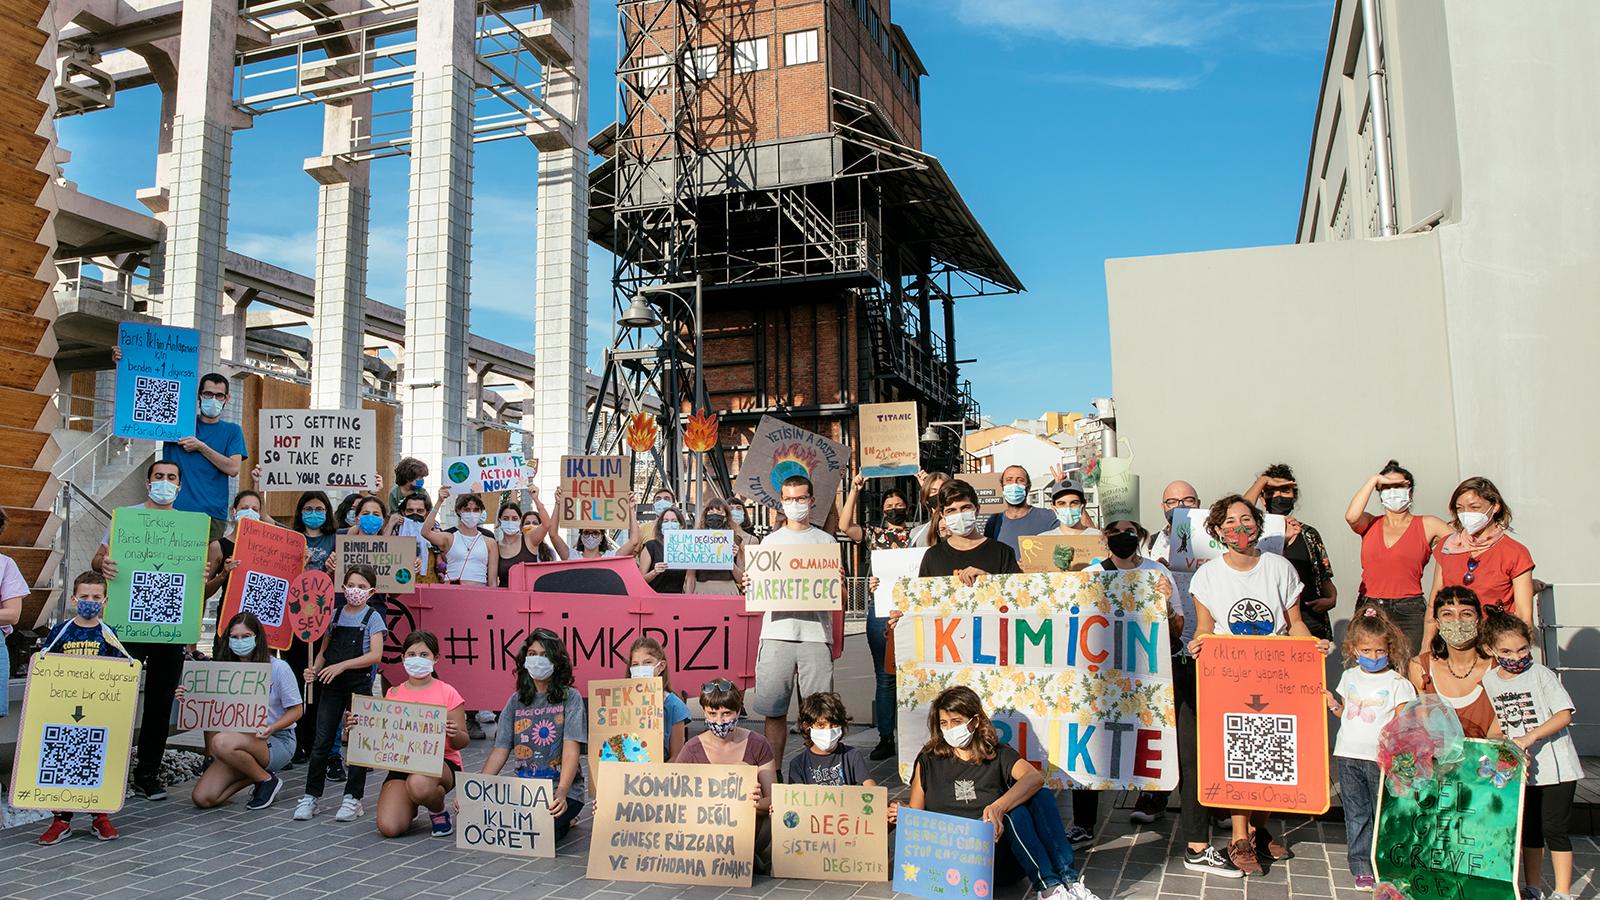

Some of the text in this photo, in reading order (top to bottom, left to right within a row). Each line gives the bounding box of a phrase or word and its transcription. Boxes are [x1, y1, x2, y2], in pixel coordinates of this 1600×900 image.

[121, 330, 143, 347] Paris
[270, 415, 361, 431] IT'S GETTING
[877, 413, 911, 422] TITANIC
[273, 435, 361, 450] HOT IN HERE
[864, 446, 875, 455] IN
[264, 450, 354, 467] SO TAKE OFF
[806, 433, 814, 444] A
[815, 438, 840, 472] DOSTLAR
[266, 472, 367, 486] ALL YOUR GOALS
[481, 468, 521, 480] ACTION
[483, 479, 510, 492] NOW
[118, 528, 141, 544] Paris
[683, 543, 711, 552] NEDEN
[746, 551, 839, 572] YOK OLMADAN
[747, 578, 839, 604] HAREKETE GEÇ
[1232, 604, 1244, 622] NO
[298, 615, 325, 631] SEV
[444, 612, 730, 672] #İKİMKRİZİ
[1066, 605, 1159, 674] İÇİN
[31, 661, 51, 677] Sen
[54, 664, 65, 677] de
[67, 667, 95, 680] merak
[183, 670, 267, 695] GELECEK
[50, 683, 121, 702] bence bir okut
[595, 687, 633, 707] TEK
[179, 699, 268, 730] İSTİYORUZ
[597, 707, 632, 726] SEN
[465, 780, 550, 809] OKULDA
[624, 772, 702, 798] KÖMÜRE
[483, 805, 532, 830] İKLİM
[615, 802, 687, 824] MADENE
[811, 814, 874, 836] DEĞİL
[1412, 813, 1475, 846] GEL
[665, 831, 735, 856] RÜZGARA
[609, 855, 629, 871] VE
[1389, 844, 1484, 879] GREVE
